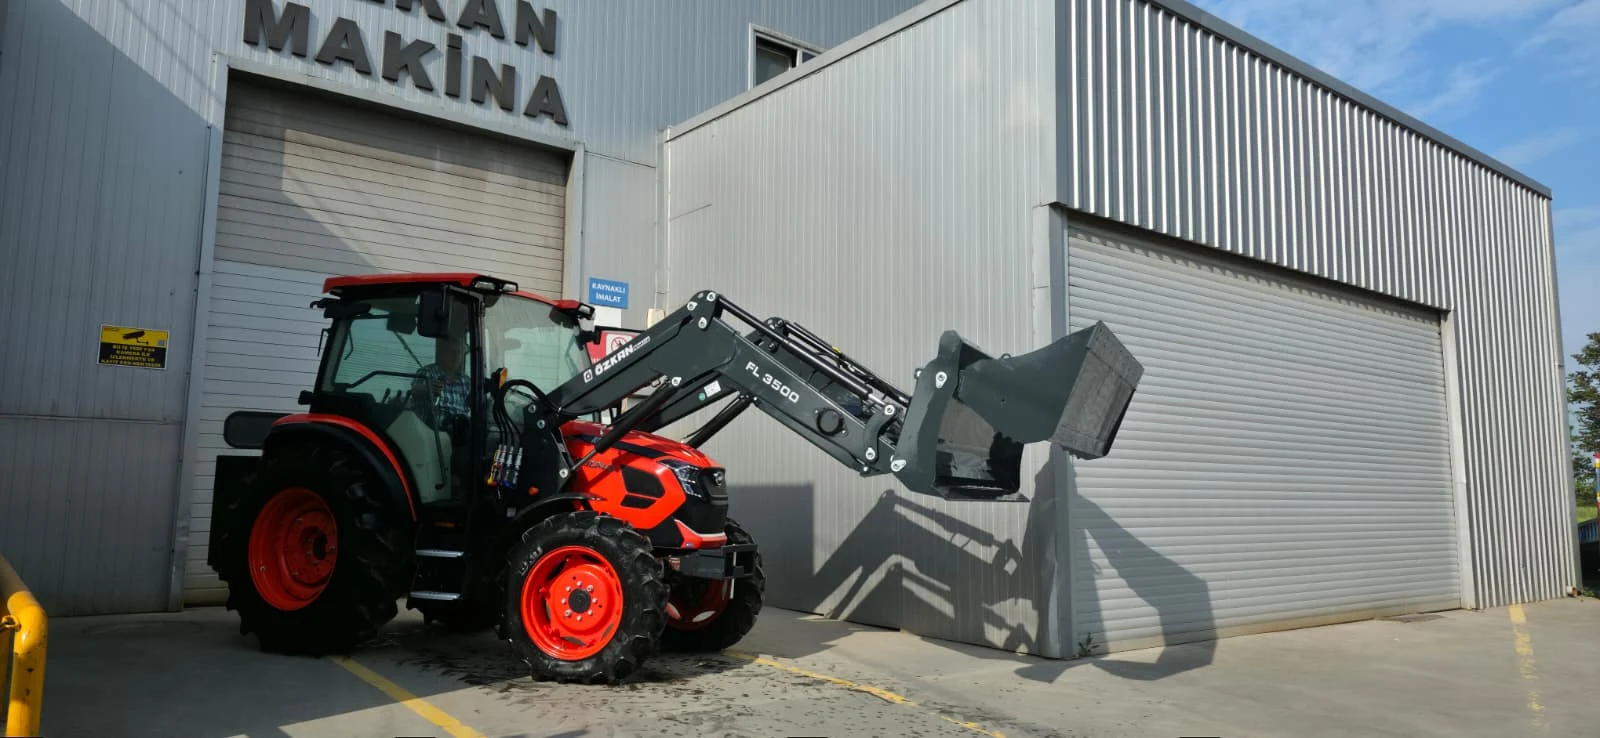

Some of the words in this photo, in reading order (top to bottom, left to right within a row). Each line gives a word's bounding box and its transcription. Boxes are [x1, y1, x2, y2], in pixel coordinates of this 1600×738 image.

[243, 0, 568, 126] MAKİNA
[595, 344, 634, 376] ÖZKAN
[745, 361, 760, 378] FL
[762, 373, 800, 403] 3500
